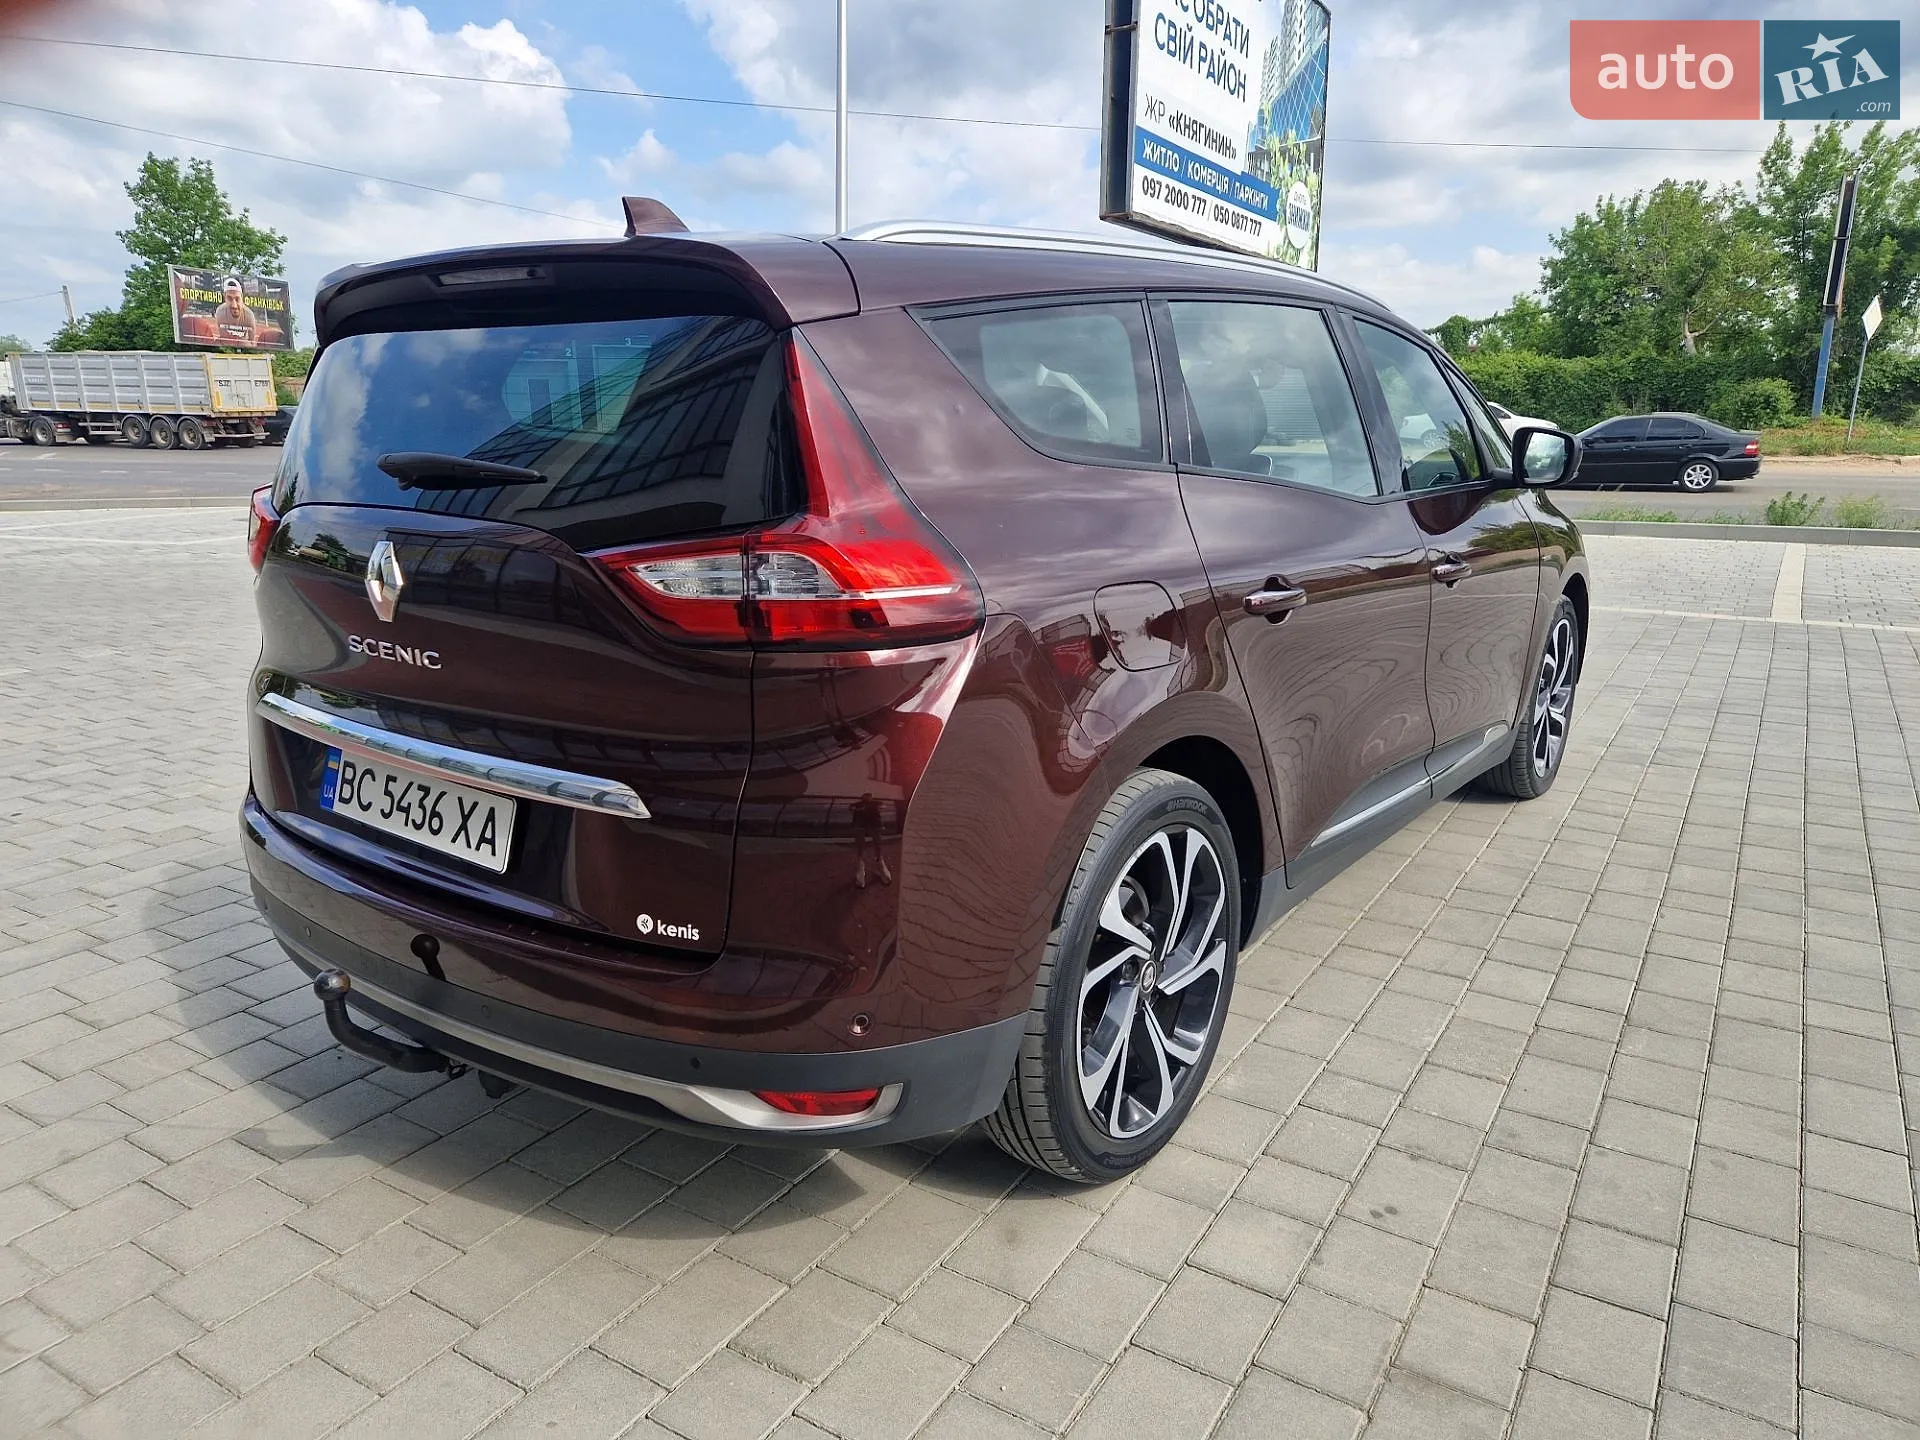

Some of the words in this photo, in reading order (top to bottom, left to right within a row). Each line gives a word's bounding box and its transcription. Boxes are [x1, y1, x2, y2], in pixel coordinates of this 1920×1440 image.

[1155, 12, 1194, 69] СВІЙ
[1198, 41, 1247, 102] РАЙОН
[1193, 0, 1250, 58] ОБРАТИ
[1144, 92, 1166, 124] ЖР
[1168, 109, 1237, 160] «КНЯГИНИН»
[1143, 138, 1180, 173] ЖИТЛО
[1187, 159, 1229, 195] КОМЕРЦІЯ
[1142, 175, 1162, 200] 097
[1164, 184, 1190, 211] 2000
[1191, 194, 1207, 217] 777
[1213, 203, 1230, 226] 050
[1231, 211, 1248, 233] 0877
[1249, 216, 1262, 237] 777
[179, 287, 223, 304] СПОРТИВНО
[348, 634, 442, 669] SCENIC
[323, 787, 334, 799] UA
[338, 760, 376, 812] BC
[380, 774, 448, 836] 5436
[450, 796, 497, 857] XA
[657, 919, 700, 941] kenis
